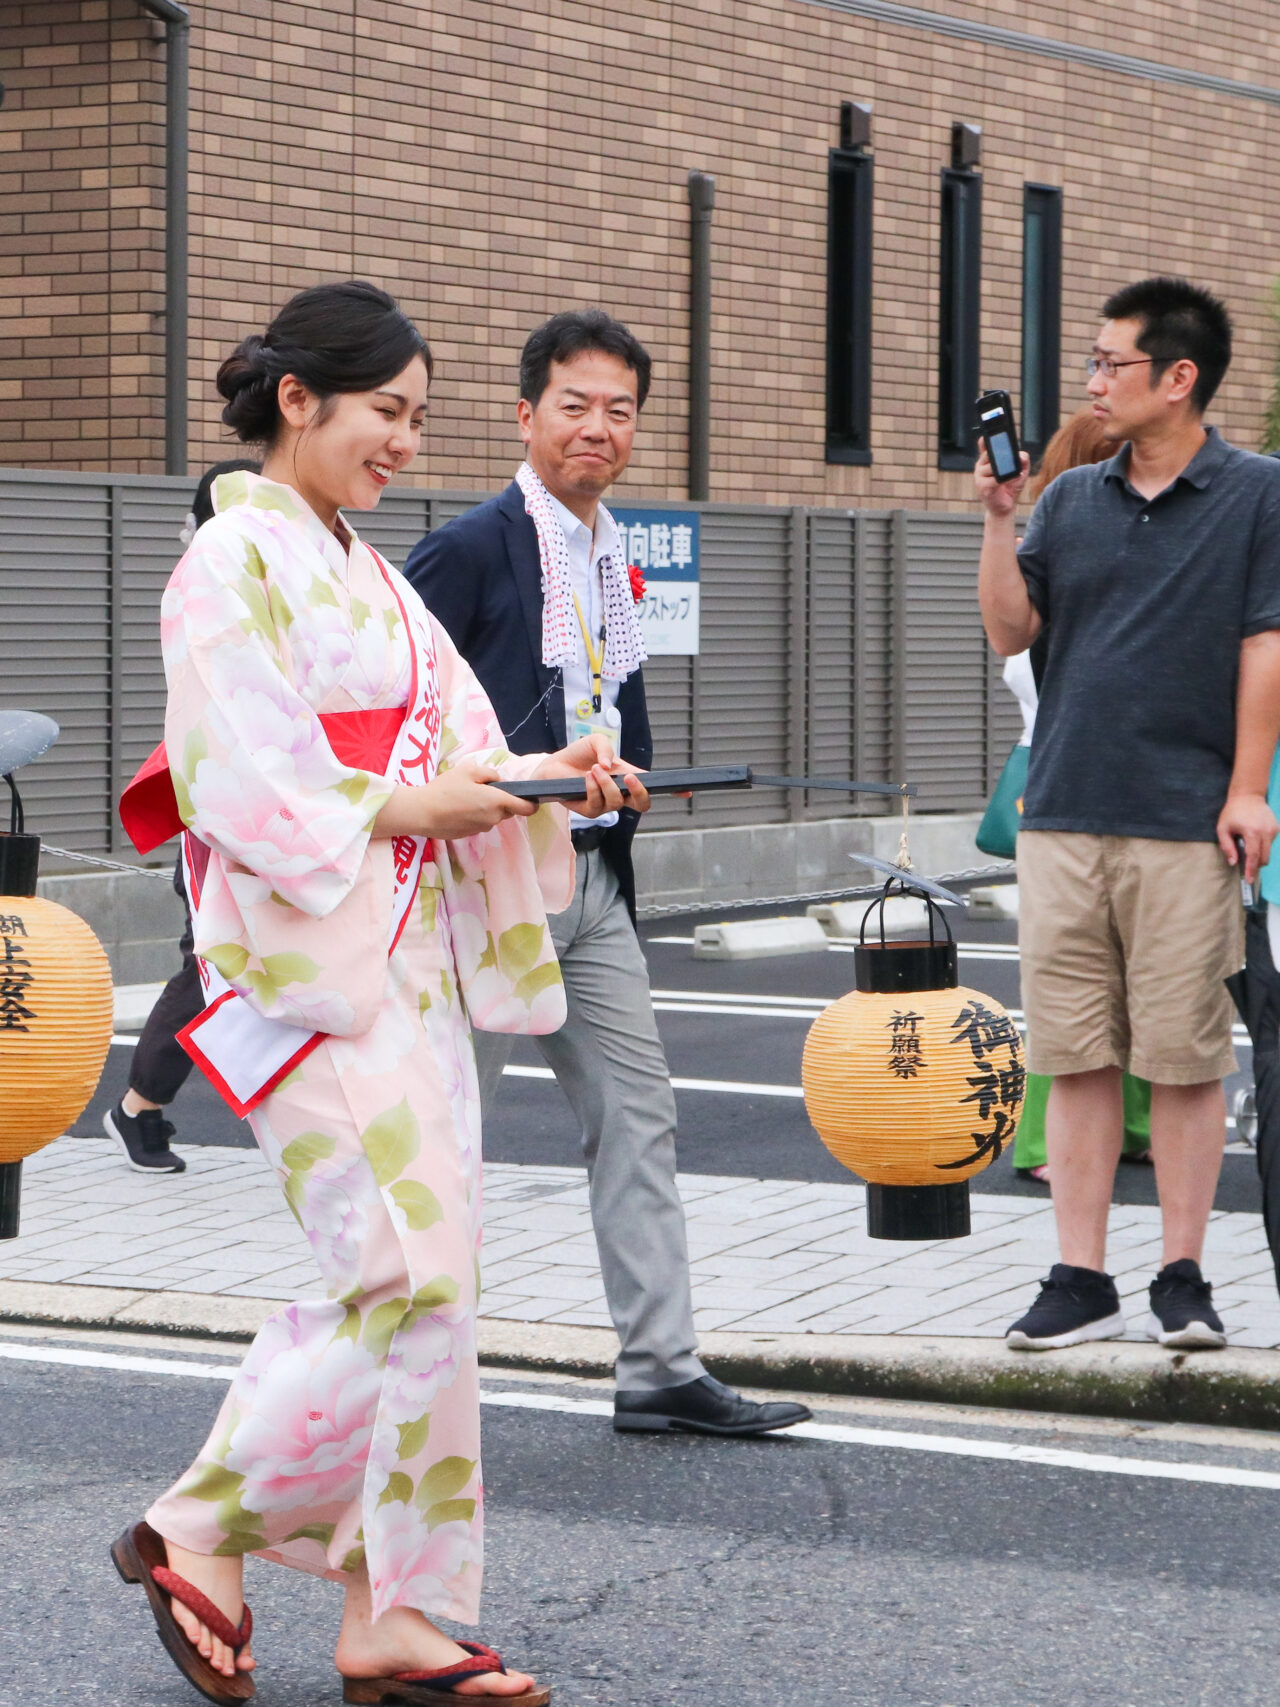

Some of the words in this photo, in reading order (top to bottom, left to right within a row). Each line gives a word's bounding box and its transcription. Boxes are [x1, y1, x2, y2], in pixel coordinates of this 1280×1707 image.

[885, 1009, 928, 1080] 祈願祭
[933, 1000, 1027, 1170] 御神火
